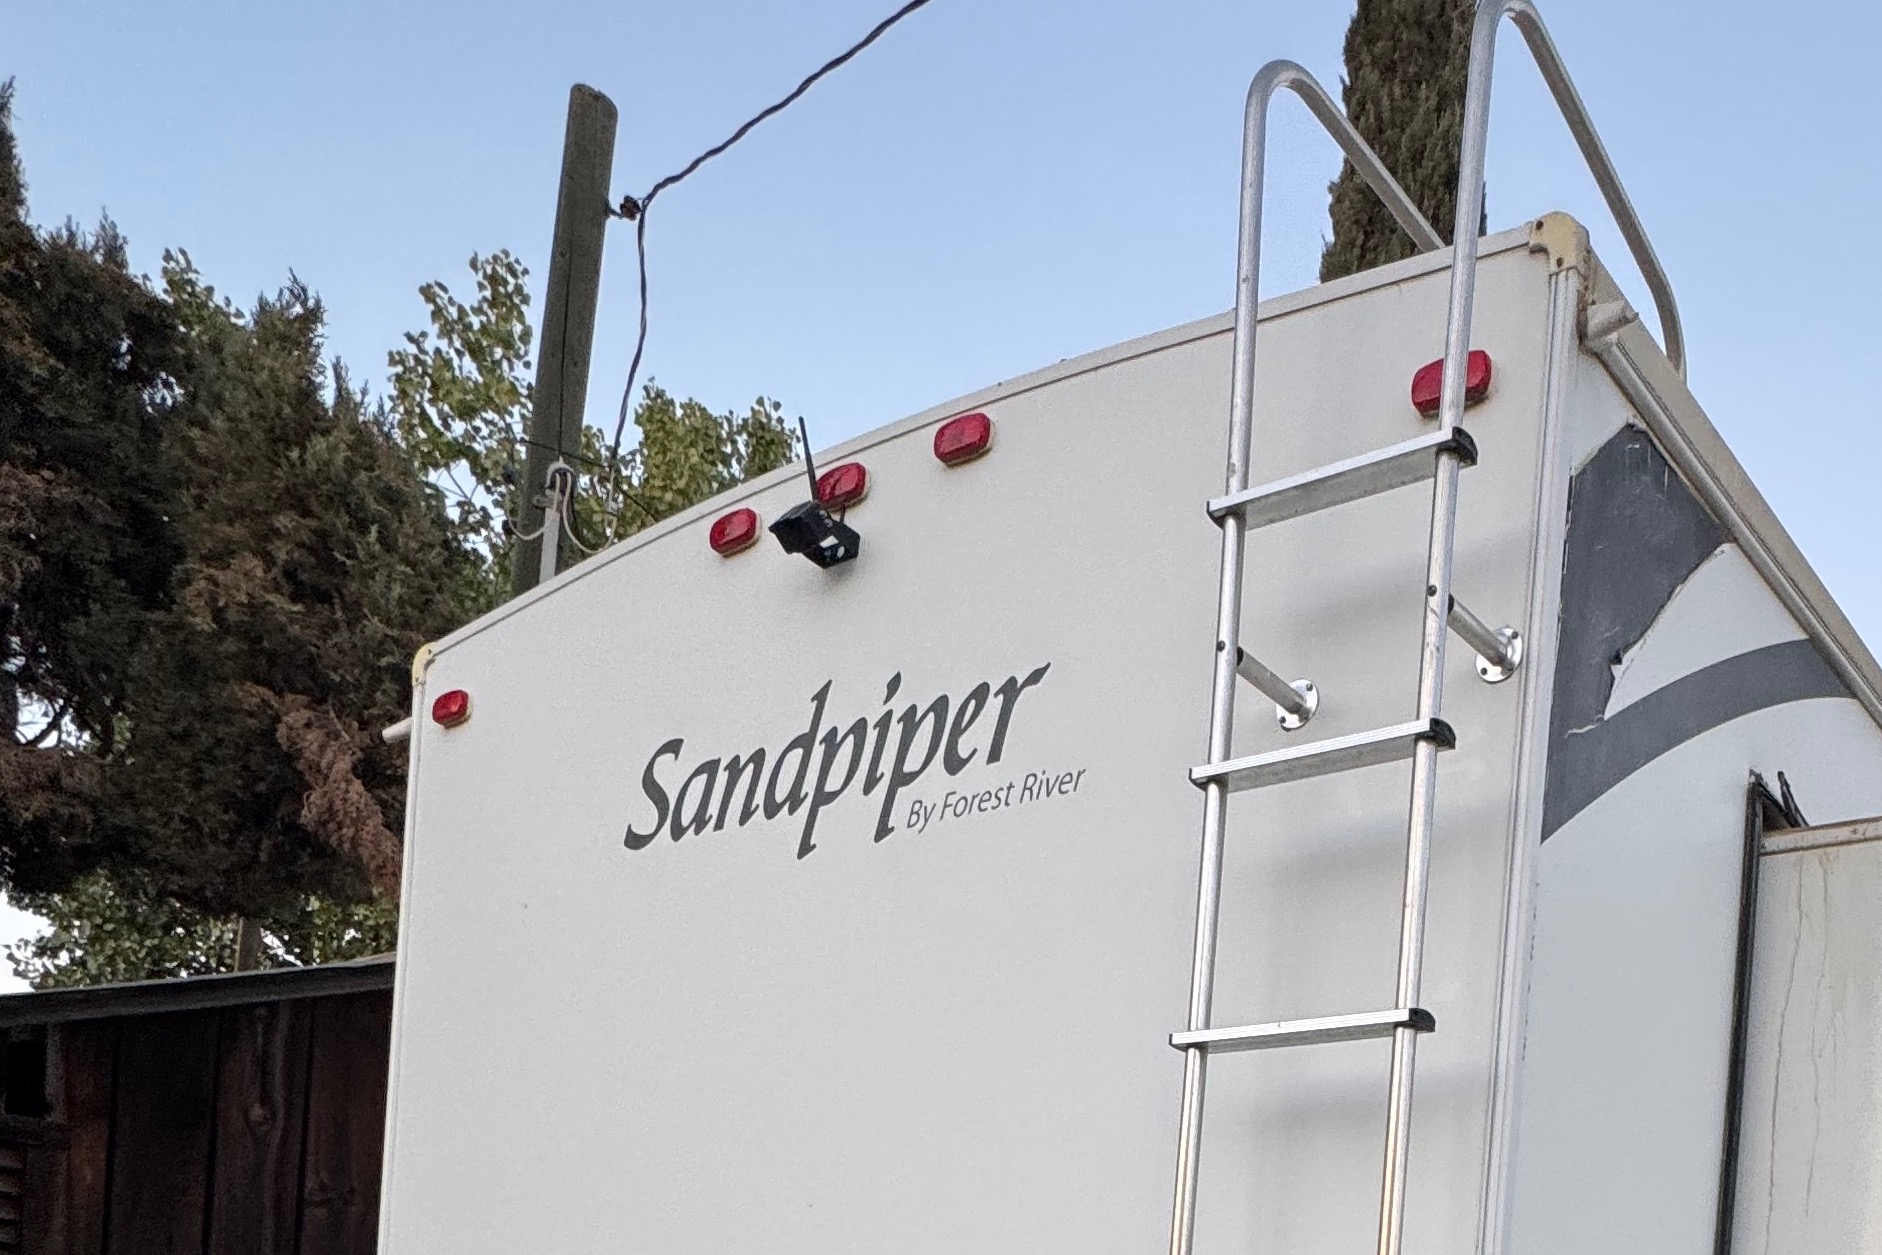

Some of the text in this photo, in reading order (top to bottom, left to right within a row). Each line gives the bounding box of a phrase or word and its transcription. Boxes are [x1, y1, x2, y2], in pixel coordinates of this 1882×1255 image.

[623, 662, 1051, 860] Sandpiper
[907, 766, 1087, 834] By Forest River
